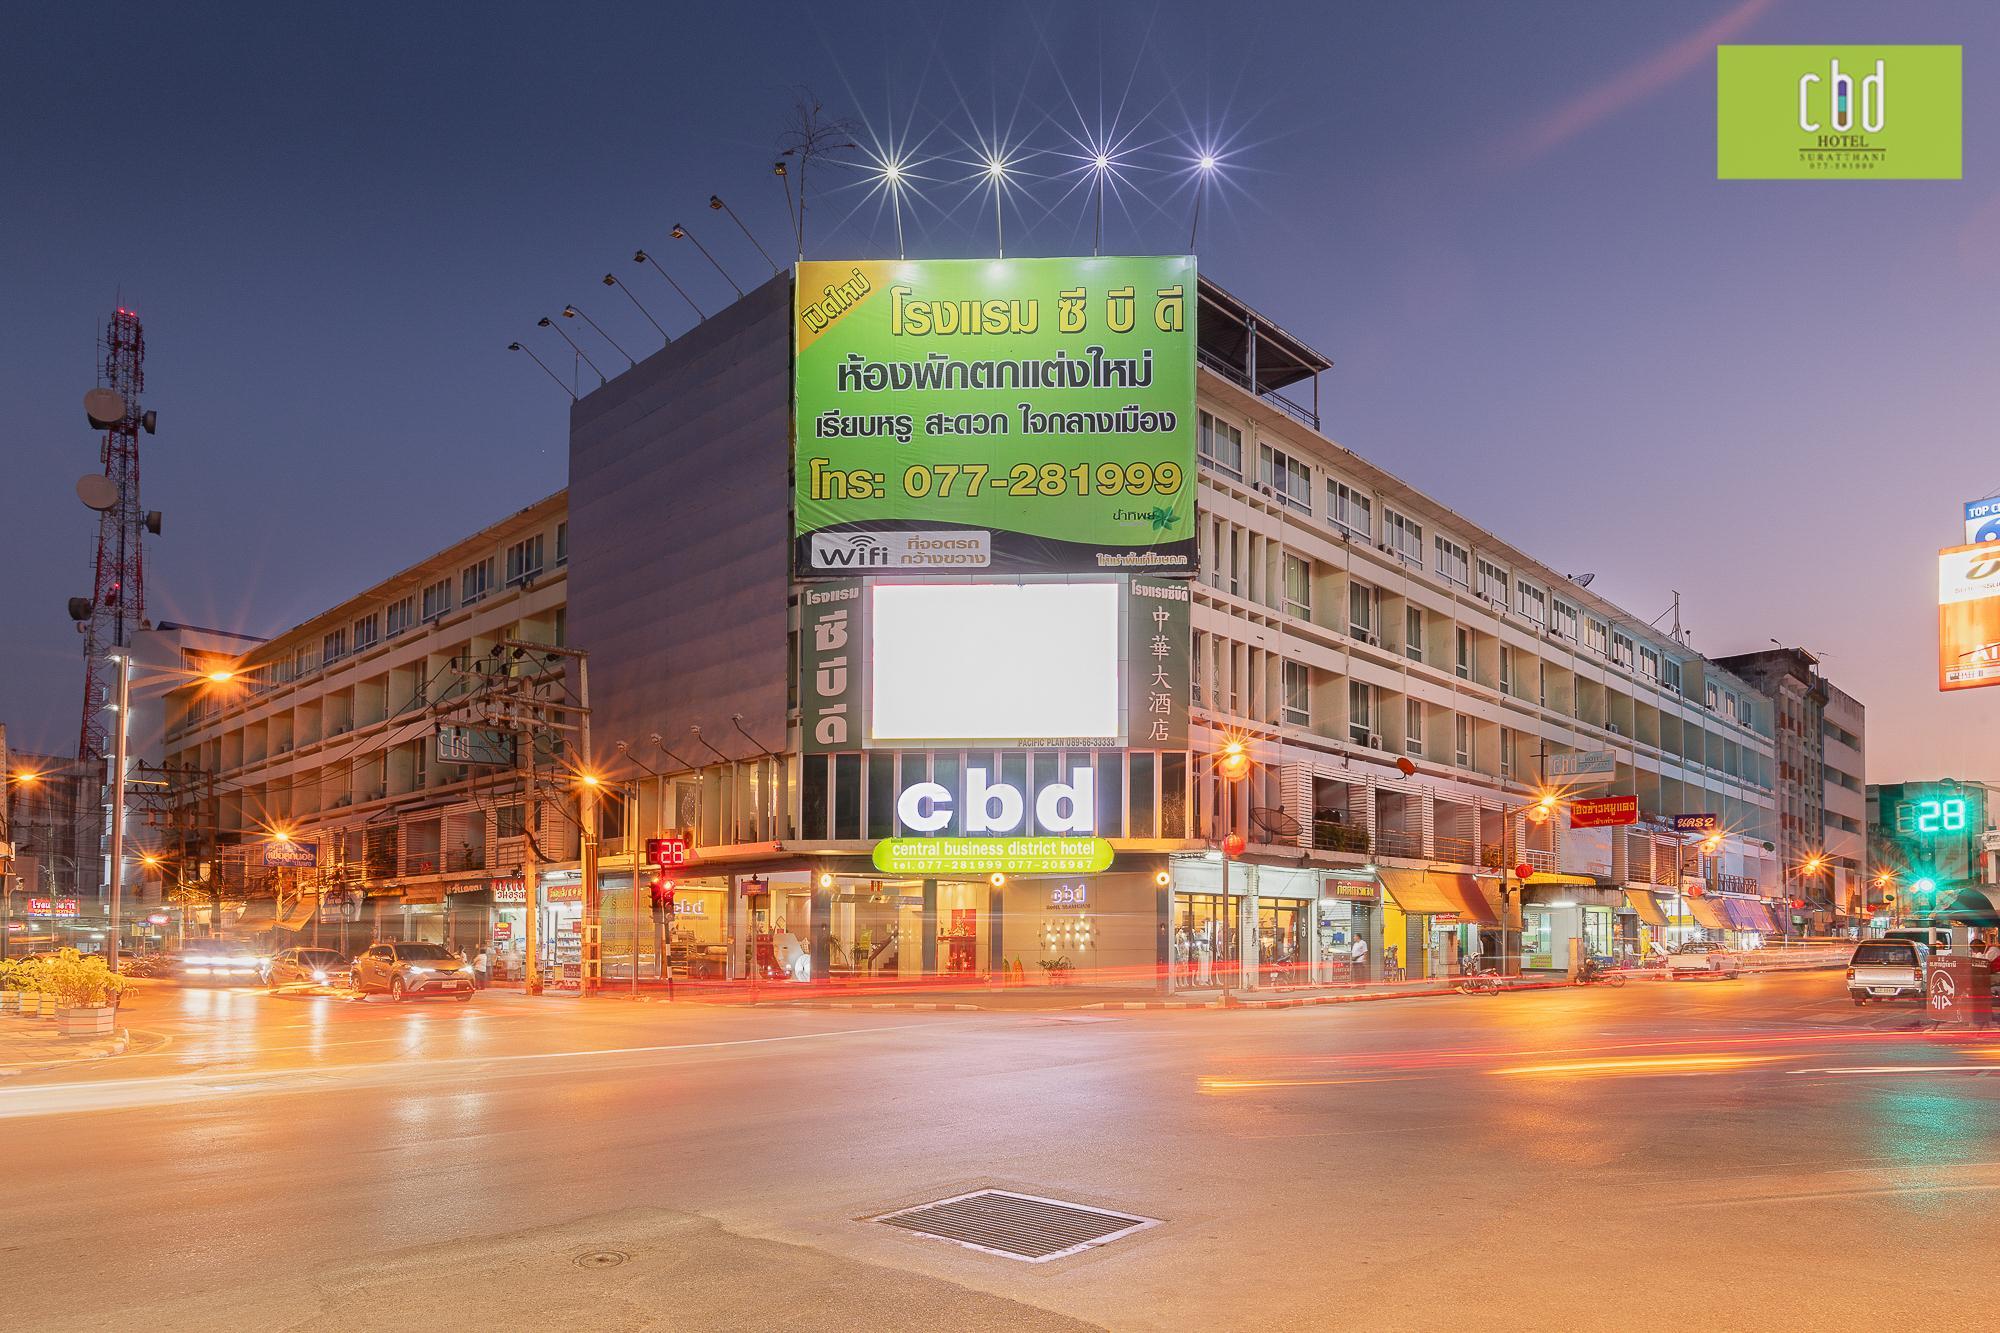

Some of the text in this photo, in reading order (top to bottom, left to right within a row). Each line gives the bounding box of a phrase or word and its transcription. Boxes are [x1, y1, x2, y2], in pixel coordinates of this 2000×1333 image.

[801, 269, 872, 334] เปิดใหม่
[890, 285, 1184, 336] โรงแรม ซี บี ดี
[837, 346, 1153, 392] ห้องพักตกแต่งใหม่
[815, 403, 1177, 444] เรียบหรู สะดวก ใจกลางเมือง
[809, 458, 1183, 500] โทร: 077-281999
[1969, 505, 1990, 518] TOP
[819, 541, 889, 566] Wifi
[900, 551, 987, 566] กว้างขวาง
[806, 587, 859, 606] โรงแรม
[1148, 606, 1171, 742] 中華大酒店
[1018, 737, 1115, 748] PACIFIC PLAN 089-66-33333
[897, 767, 1094, 832] cbd
[1919, 799, 1965, 832] 28
[661, 842, 684, 864] 28
[892, 840, 1095, 857] central business district hotel
[1008, 860, 1093, 869] 077-205987
[1932, 995, 1953, 1010] AIA
